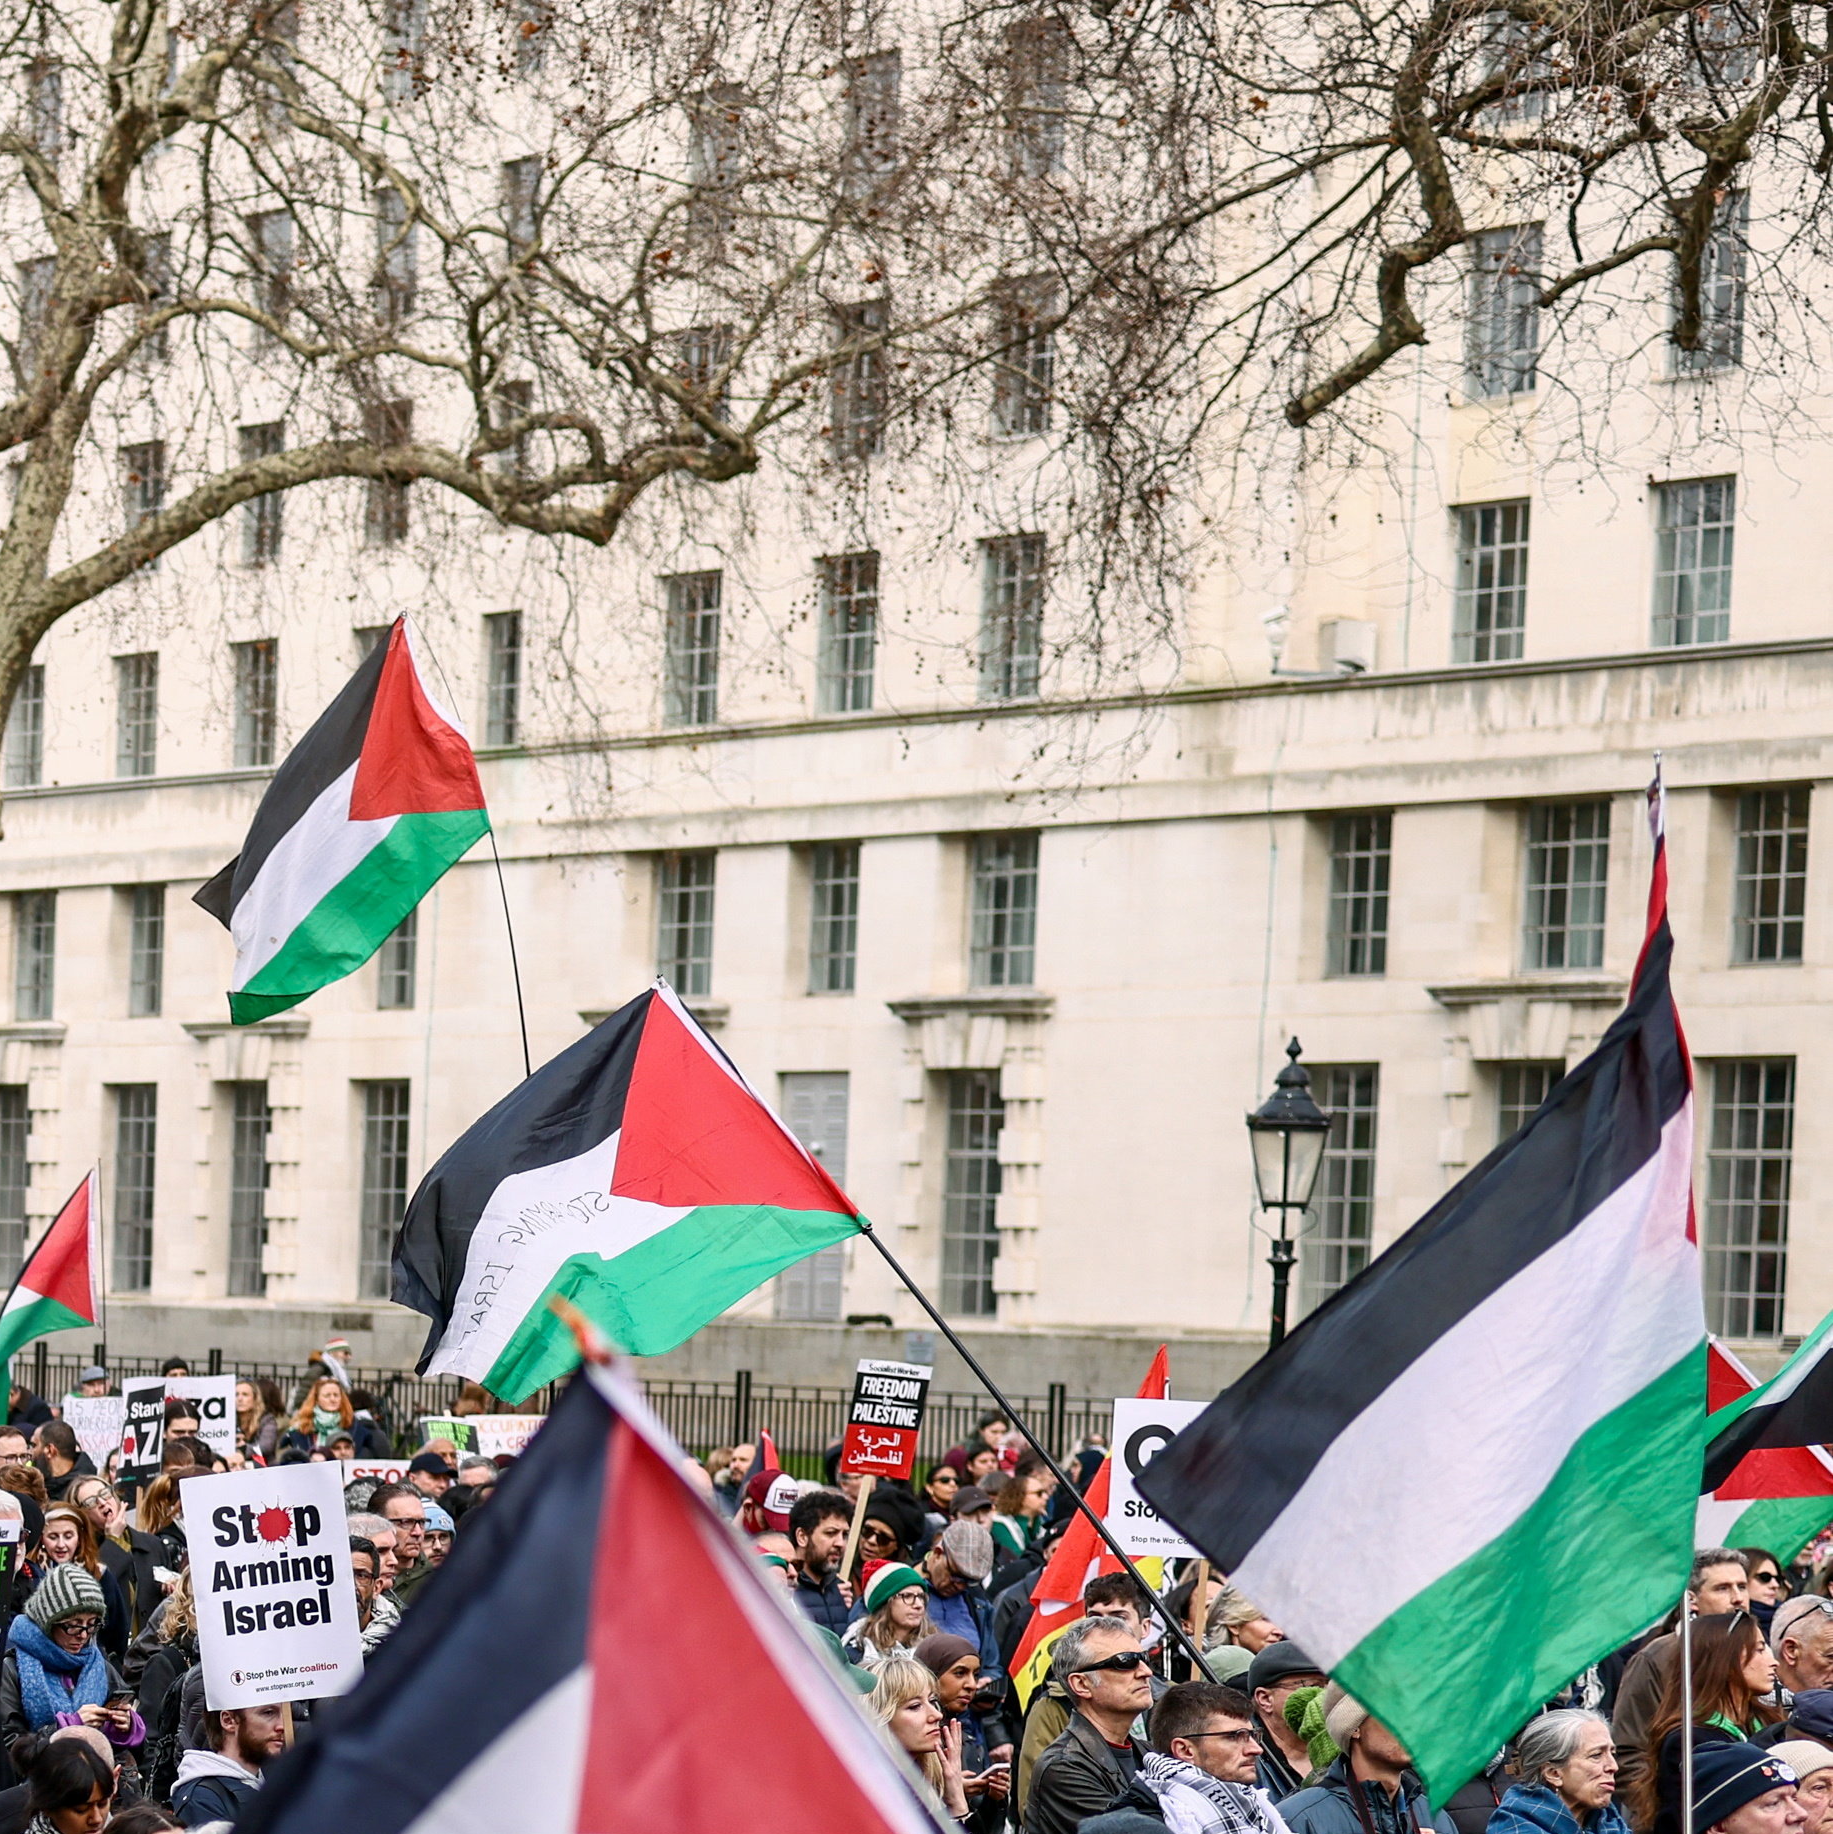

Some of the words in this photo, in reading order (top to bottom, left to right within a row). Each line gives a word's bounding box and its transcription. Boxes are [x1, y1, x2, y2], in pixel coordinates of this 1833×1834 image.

[861, 1376, 921, 1400] FREEDOM
[852, 1402, 919, 1427] PALESTINE
[212, 1503, 321, 1548] Stp
[1131, 1536, 1149, 1544] Stop
[1149, 1536, 1161, 1544] the
[212, 1552, 333, 1592] Arming
[223, 1588, 331, 1636] Israel
[245, 1670, 265, 1682] Stop
[265, 1668, 279, 1678] the
[281, 1666, 299, 1675] War
[299, 1662, 338, 1673] coalition
[255, 1679, 315, 1693] www.stopwar.org.uk
